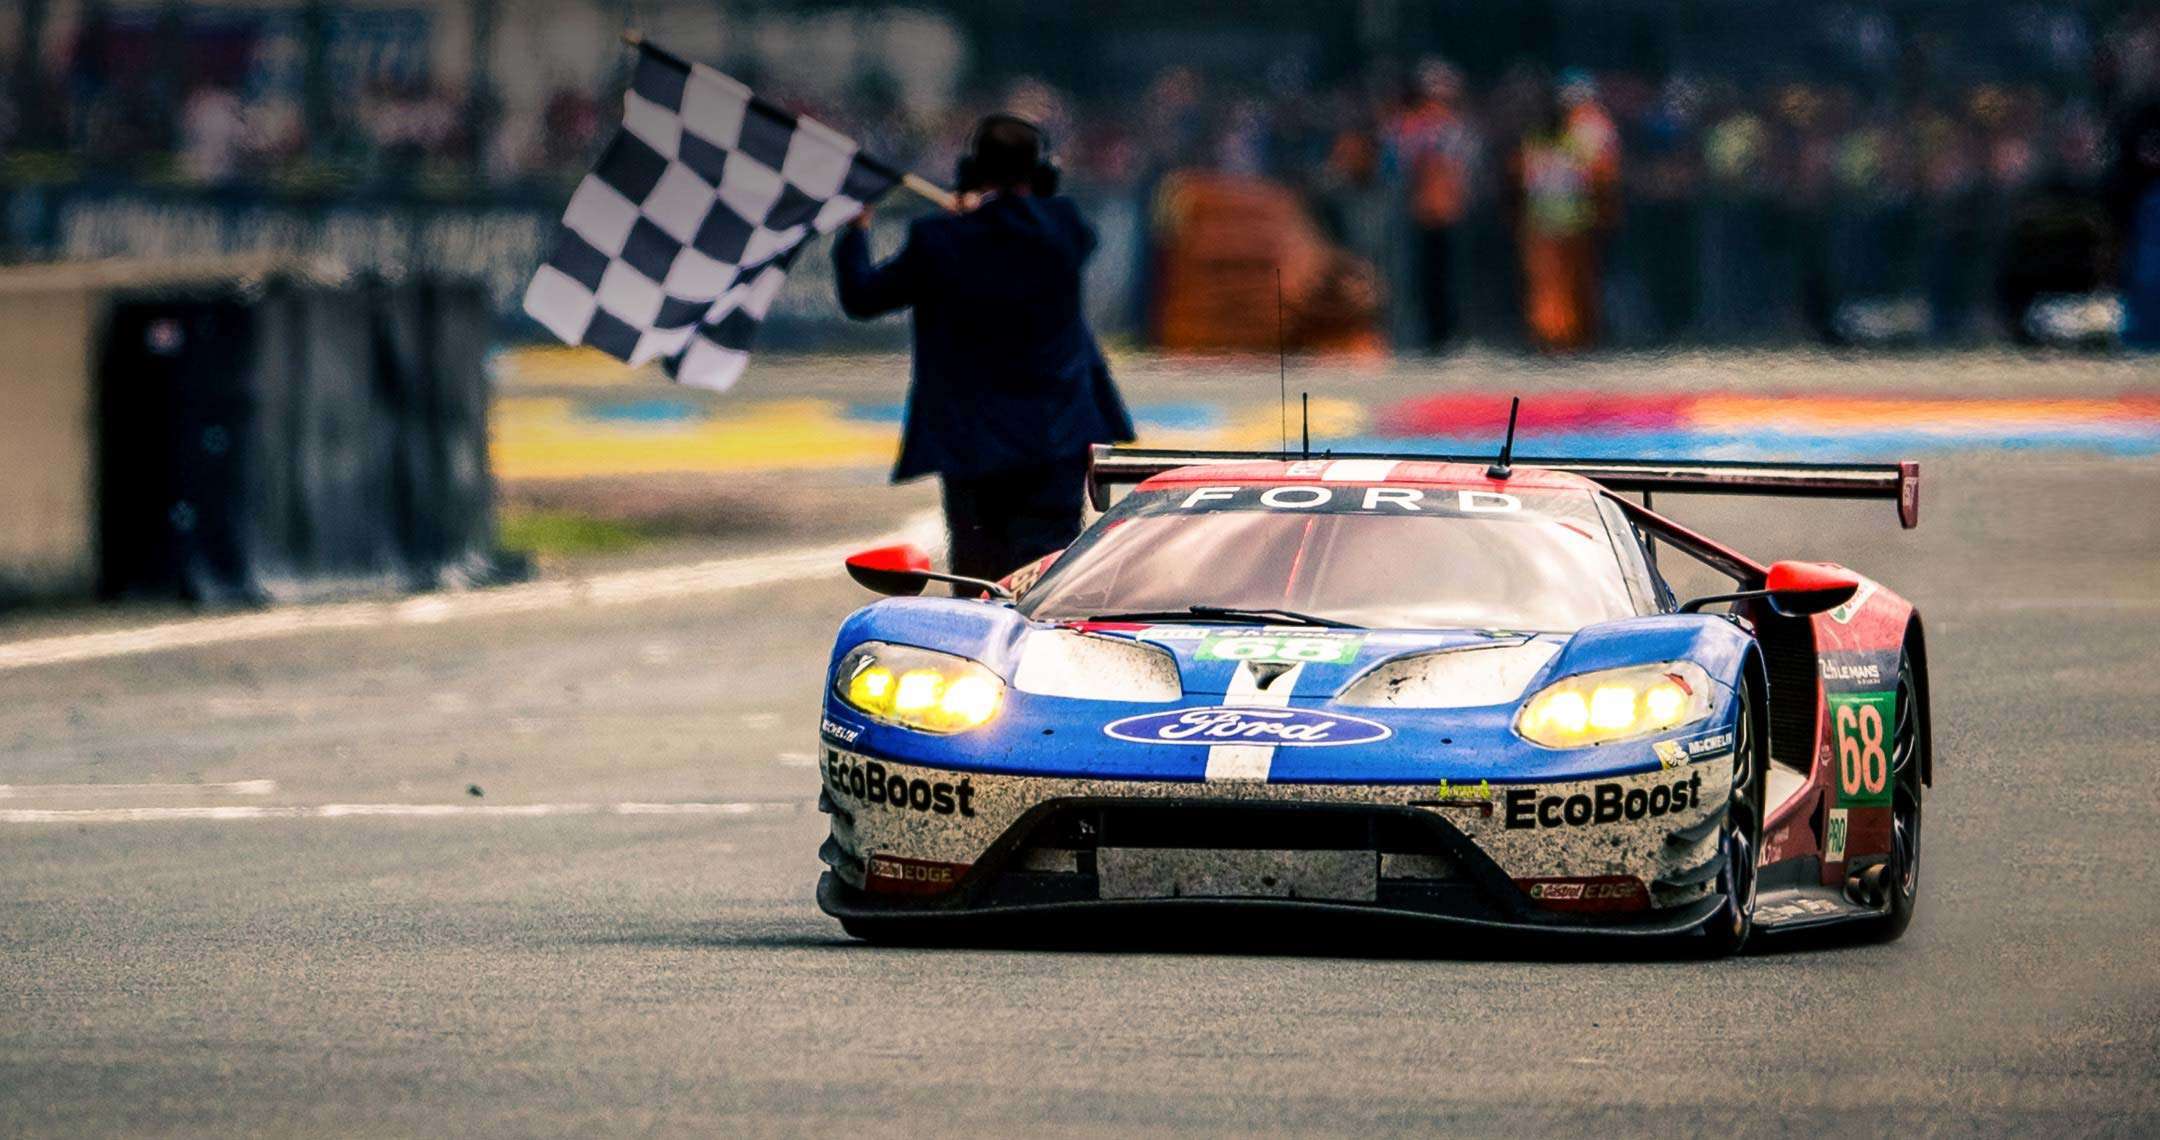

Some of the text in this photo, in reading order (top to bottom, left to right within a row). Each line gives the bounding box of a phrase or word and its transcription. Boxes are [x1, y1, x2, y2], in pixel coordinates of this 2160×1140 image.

[1179, 485, 1523, 514] FORD
[1158, 710, 1335, 741] Ford
[1836, 704, 1887, 795] 68
[827, 749, 976, 818] EcoBoost
[1505, 770, 1702, 830] EcoBoost
[903, 864, 954, 883] EDGE
